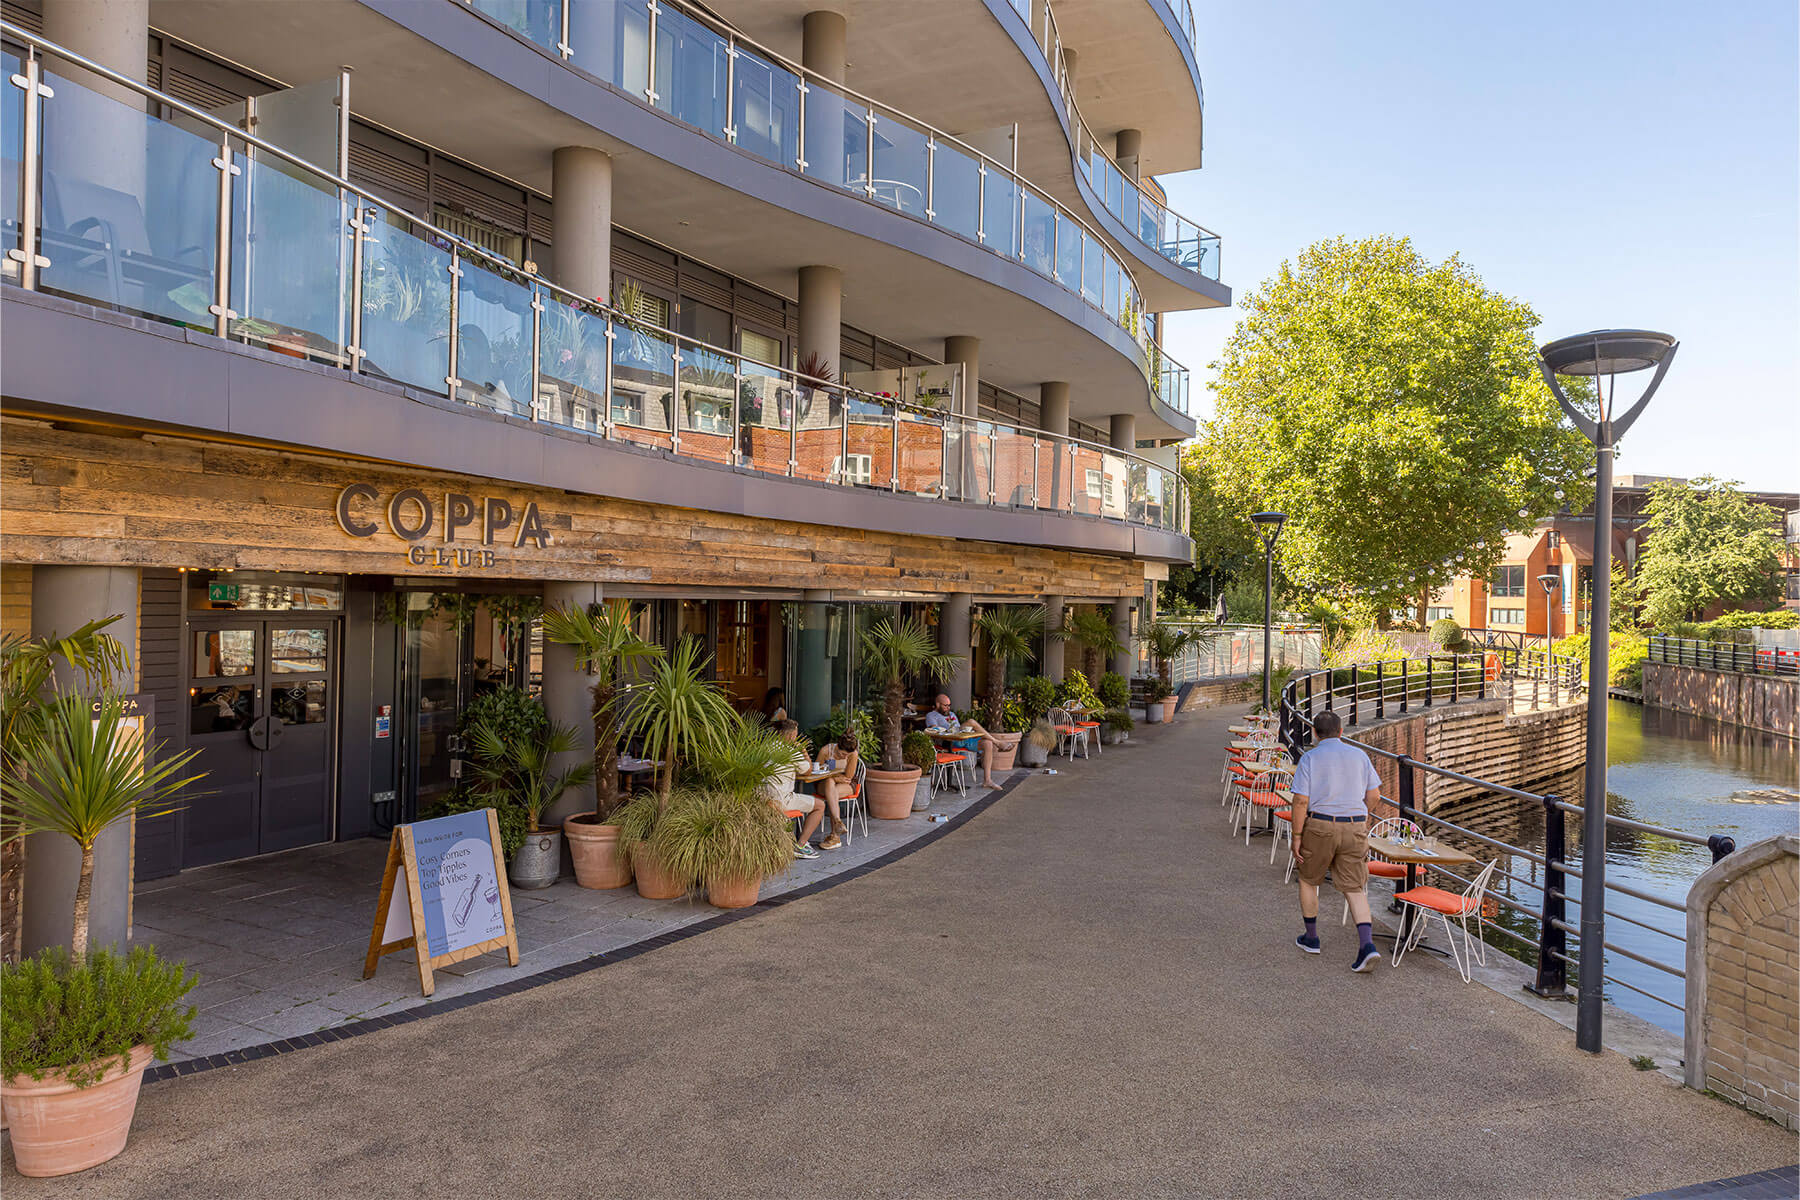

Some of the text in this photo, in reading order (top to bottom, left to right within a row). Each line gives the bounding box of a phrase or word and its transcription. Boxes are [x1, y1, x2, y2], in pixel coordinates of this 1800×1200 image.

[336, 483, 556, 549] COPPA
[408, 545, 496, 569] CLUB
[419, 848, 471, 866] Cosy Corners
[420, 861, 467, 878] Top Tipples
[423, 873, 468, 889] Good Vibes
